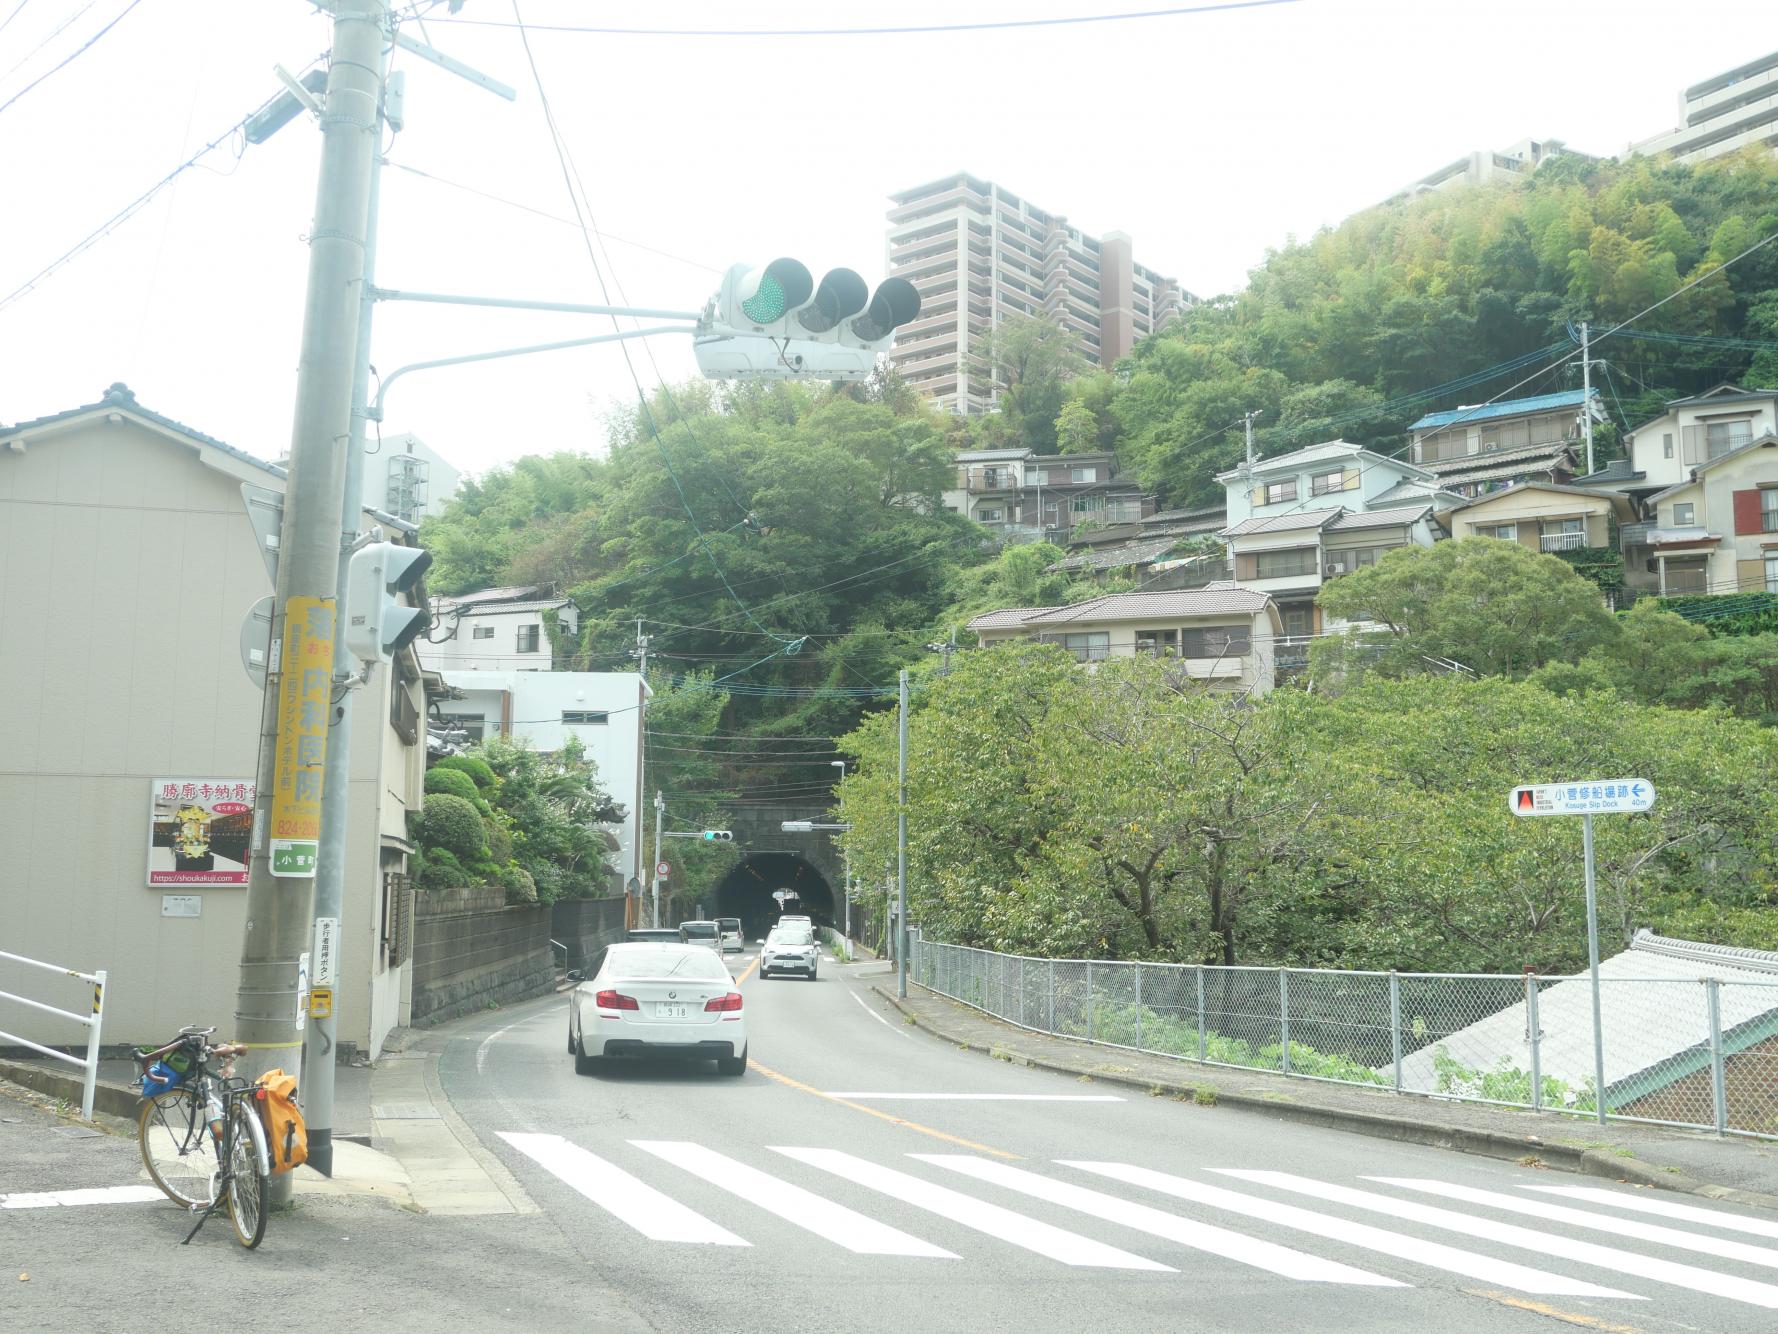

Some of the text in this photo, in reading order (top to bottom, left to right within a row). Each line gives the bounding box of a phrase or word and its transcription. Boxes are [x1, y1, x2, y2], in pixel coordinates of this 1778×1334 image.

[1554, 785, 1629, 801] 小菅修船場跡
[1565, 800, 1618, 810] Kosuge Slip Dock
[153, 874, 233, 883] https://shoukakuji.com
[319, 922, 331, 982] 歩行者用押ボタン
